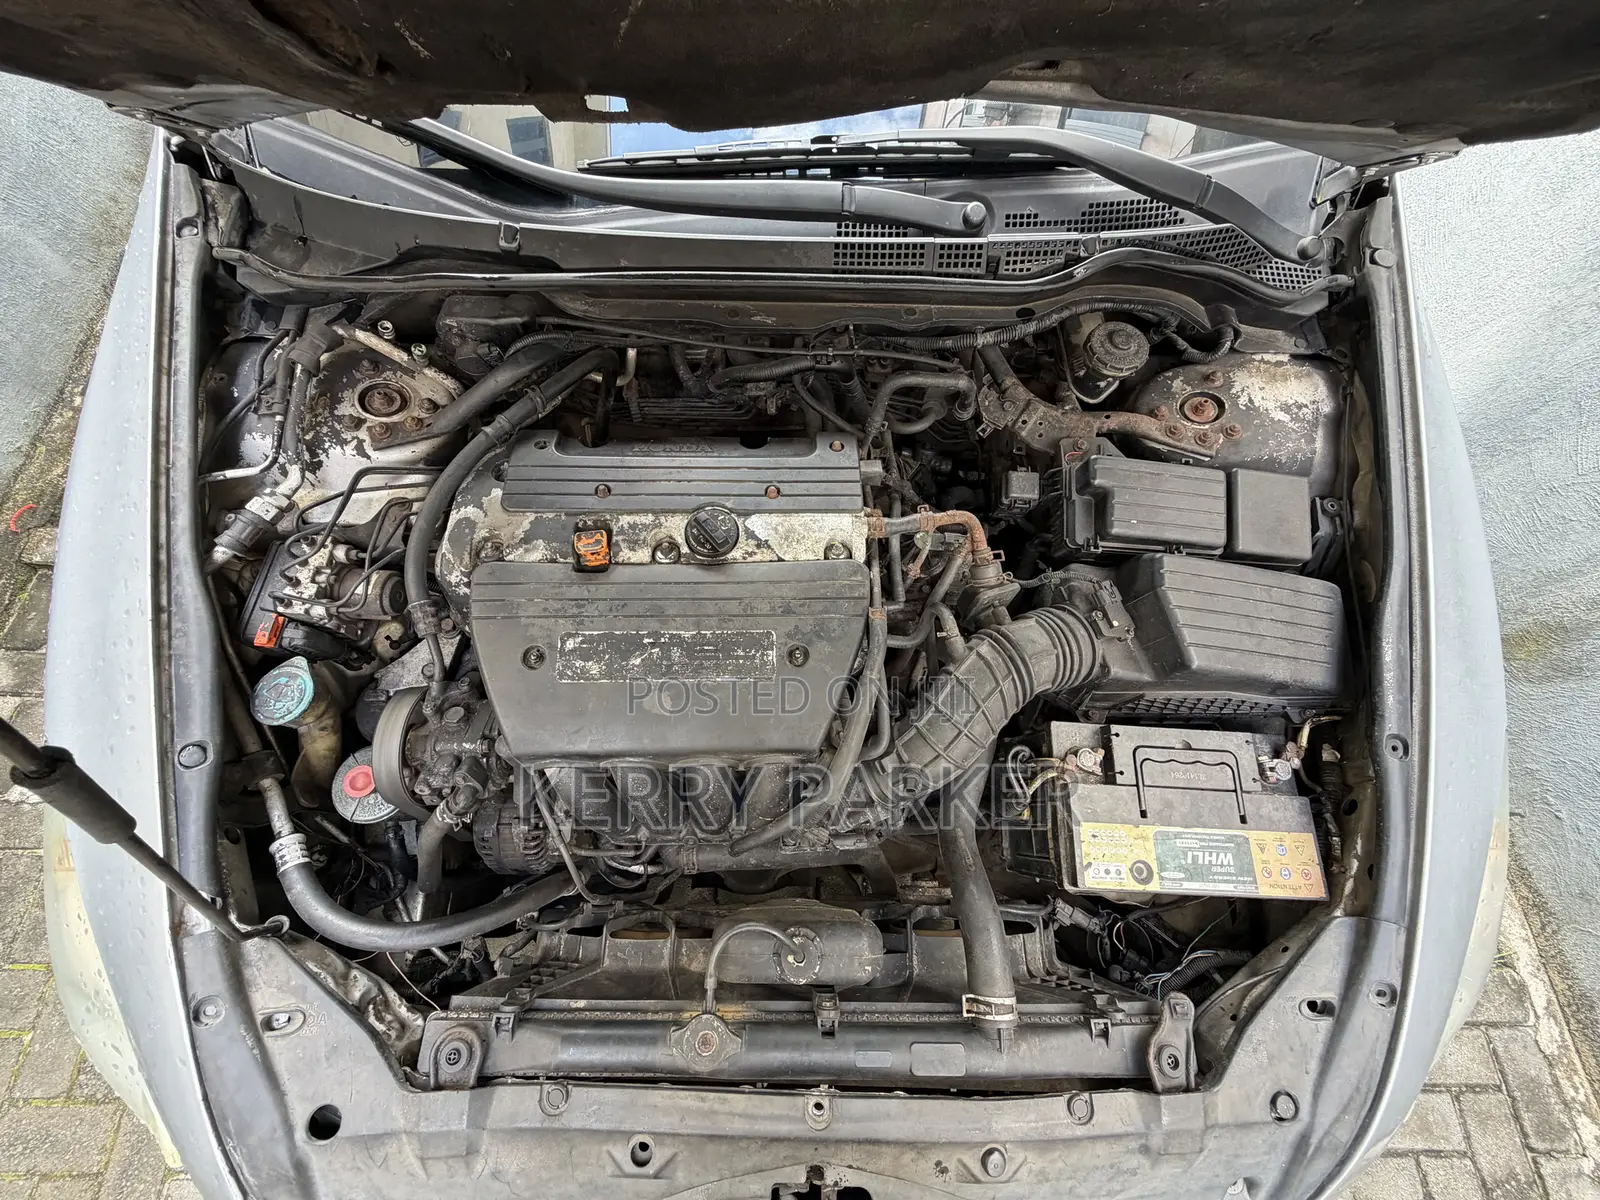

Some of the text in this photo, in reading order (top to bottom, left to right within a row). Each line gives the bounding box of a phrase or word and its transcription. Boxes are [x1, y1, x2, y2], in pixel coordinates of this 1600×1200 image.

[631, 443, 714, 453] HONDA
[1187, 851, 1234, 865] WHLI
[1211, 866, 1236, 874] SUPER
[1269, 883, 1302, 891] ATTENTION
